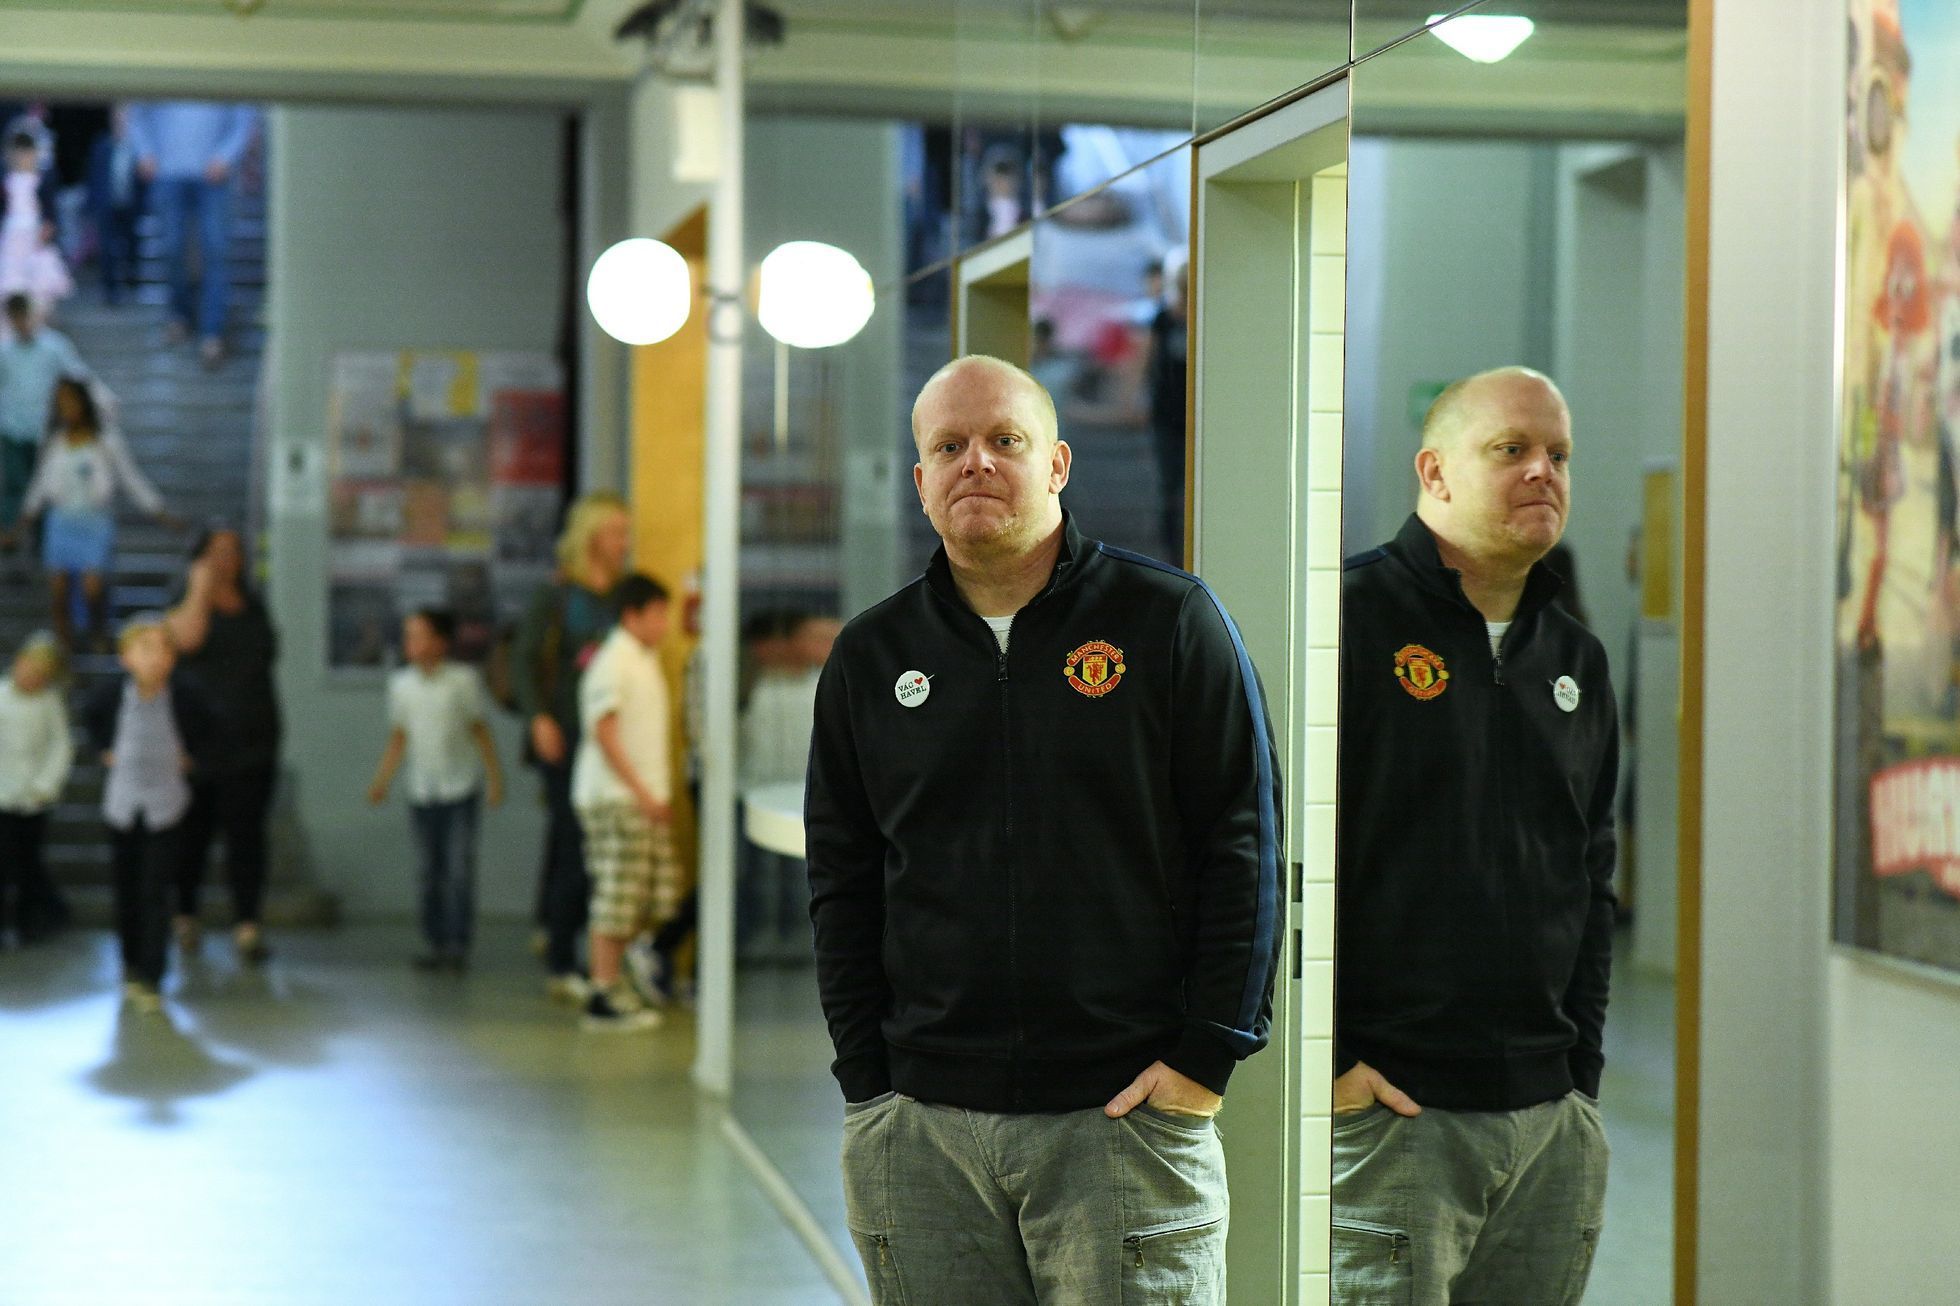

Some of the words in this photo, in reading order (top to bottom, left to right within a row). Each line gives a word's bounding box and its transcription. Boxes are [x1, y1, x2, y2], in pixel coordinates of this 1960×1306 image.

[1070, 644, 1120, 662] MANCHESTER
[900, 685, 927, 700] HAVEL
[1077, 683, 1112, 694] UNITED
